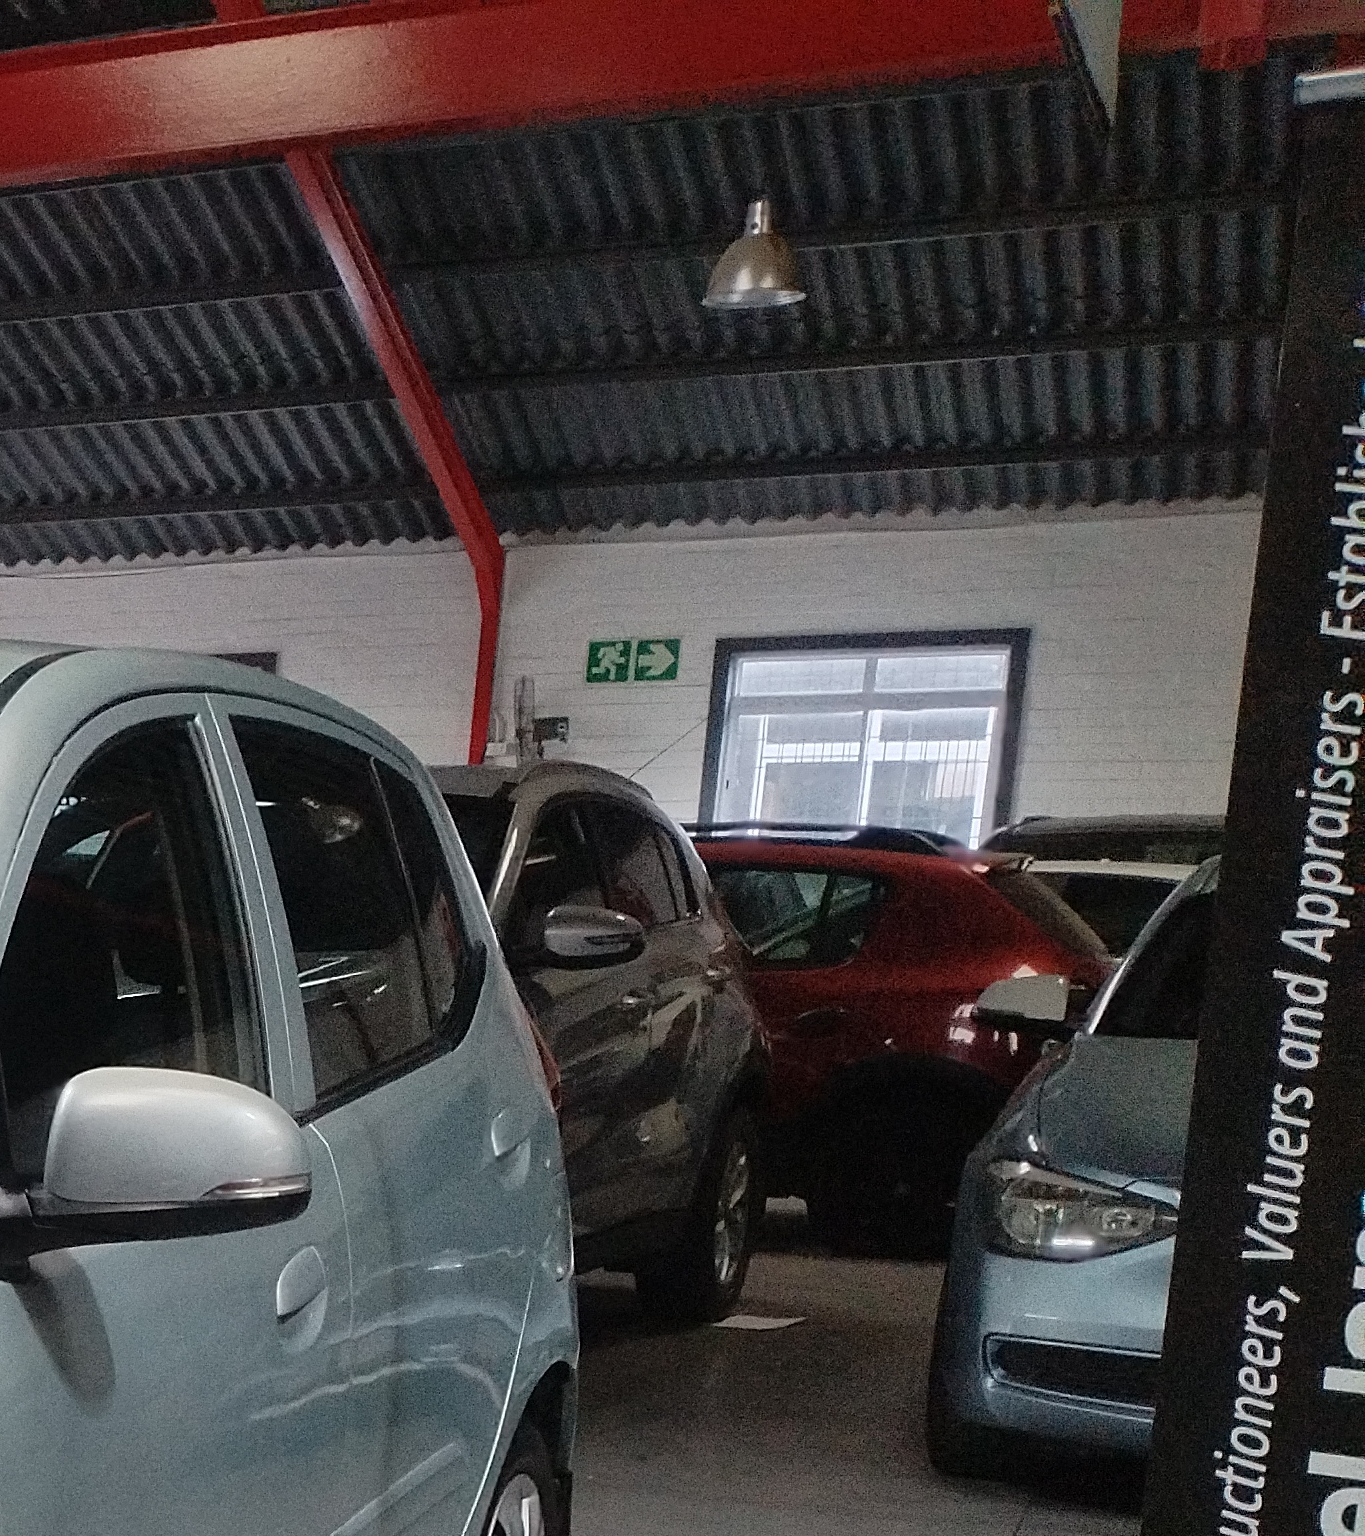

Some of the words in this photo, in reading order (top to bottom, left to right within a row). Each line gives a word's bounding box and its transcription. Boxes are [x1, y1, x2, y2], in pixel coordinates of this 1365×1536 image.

[1280, 690, 1365, 963] Appraisers
[1273, 968, 1329, 1071] and
[1240, 1083, 1314, 1260] Valuers
